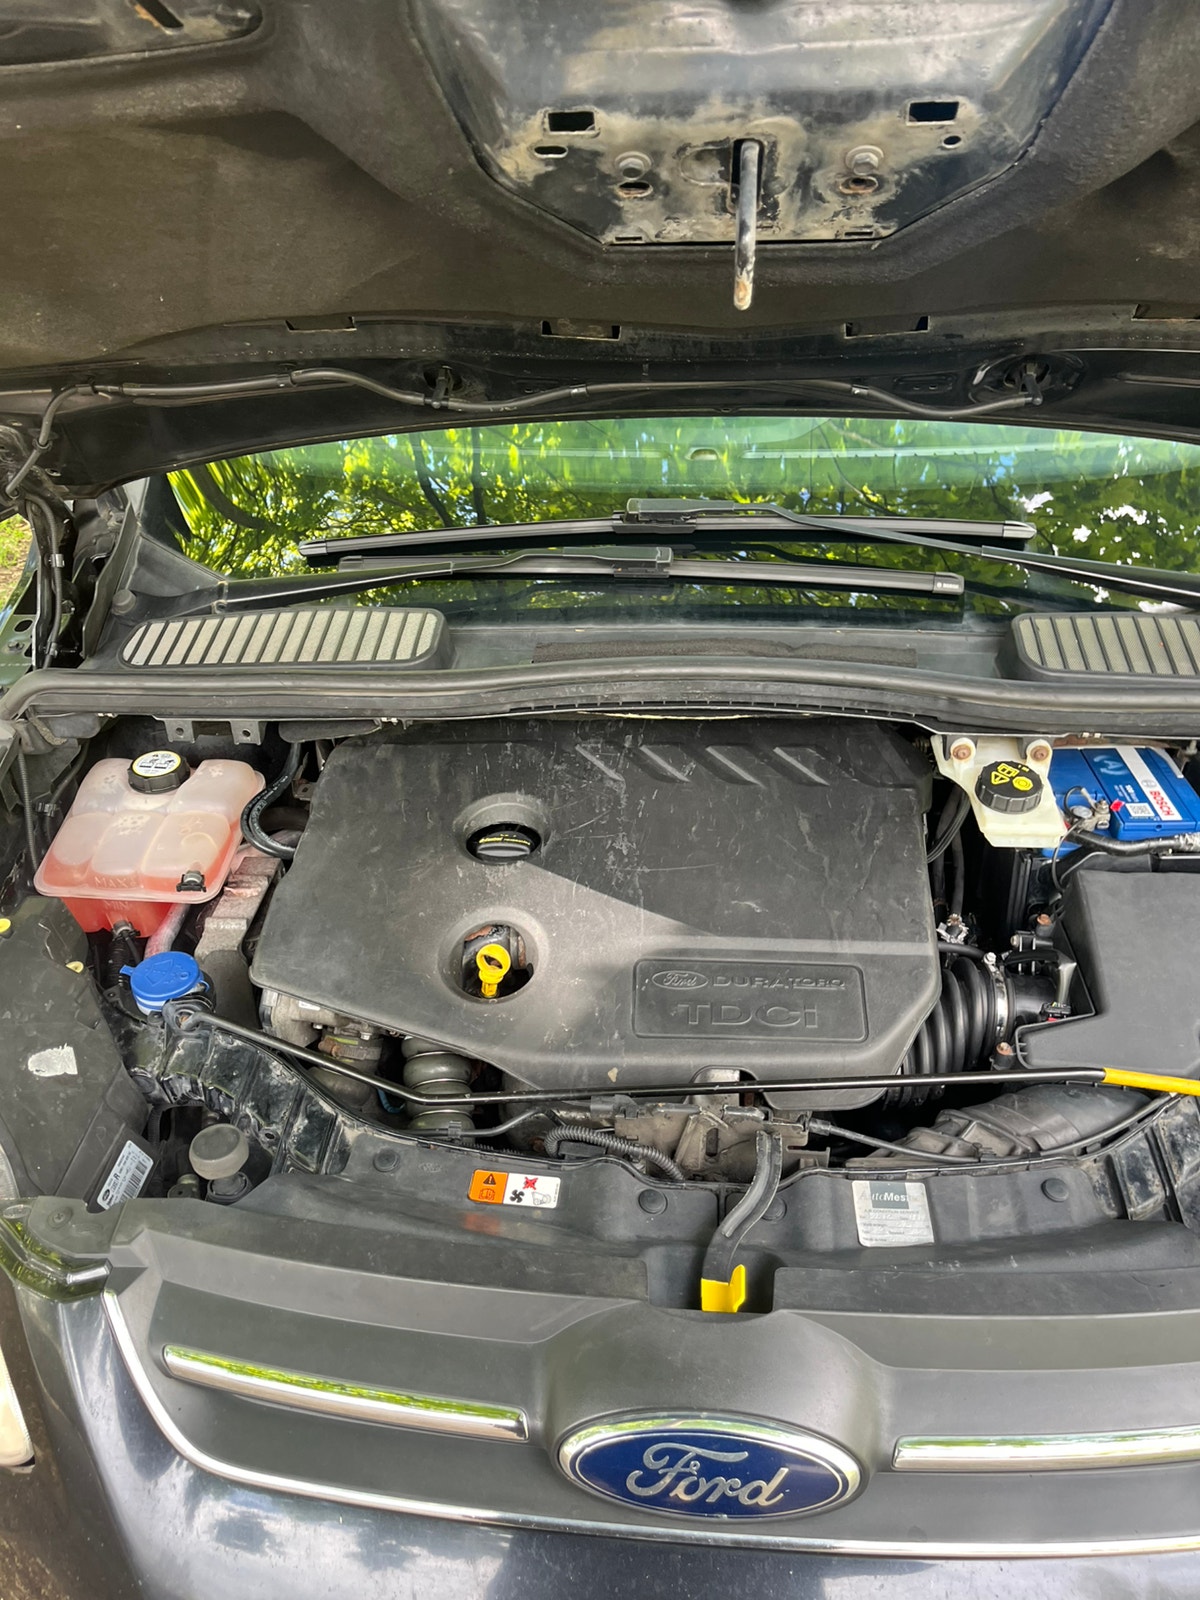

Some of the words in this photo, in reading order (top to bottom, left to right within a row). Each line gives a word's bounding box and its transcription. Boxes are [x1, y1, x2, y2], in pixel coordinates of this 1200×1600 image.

[1150, 790, 1175, 816] BOSCH
[94, 876, 128, 888] MAX
[104, 900, 130, 911] MIN
[663, 973, 697, 987] Ford
[713, 976, 845, 990] DURATORQ
[677, 1001, 819, 1028] TDCi
[625, 1442, 790, 1506] Ford
